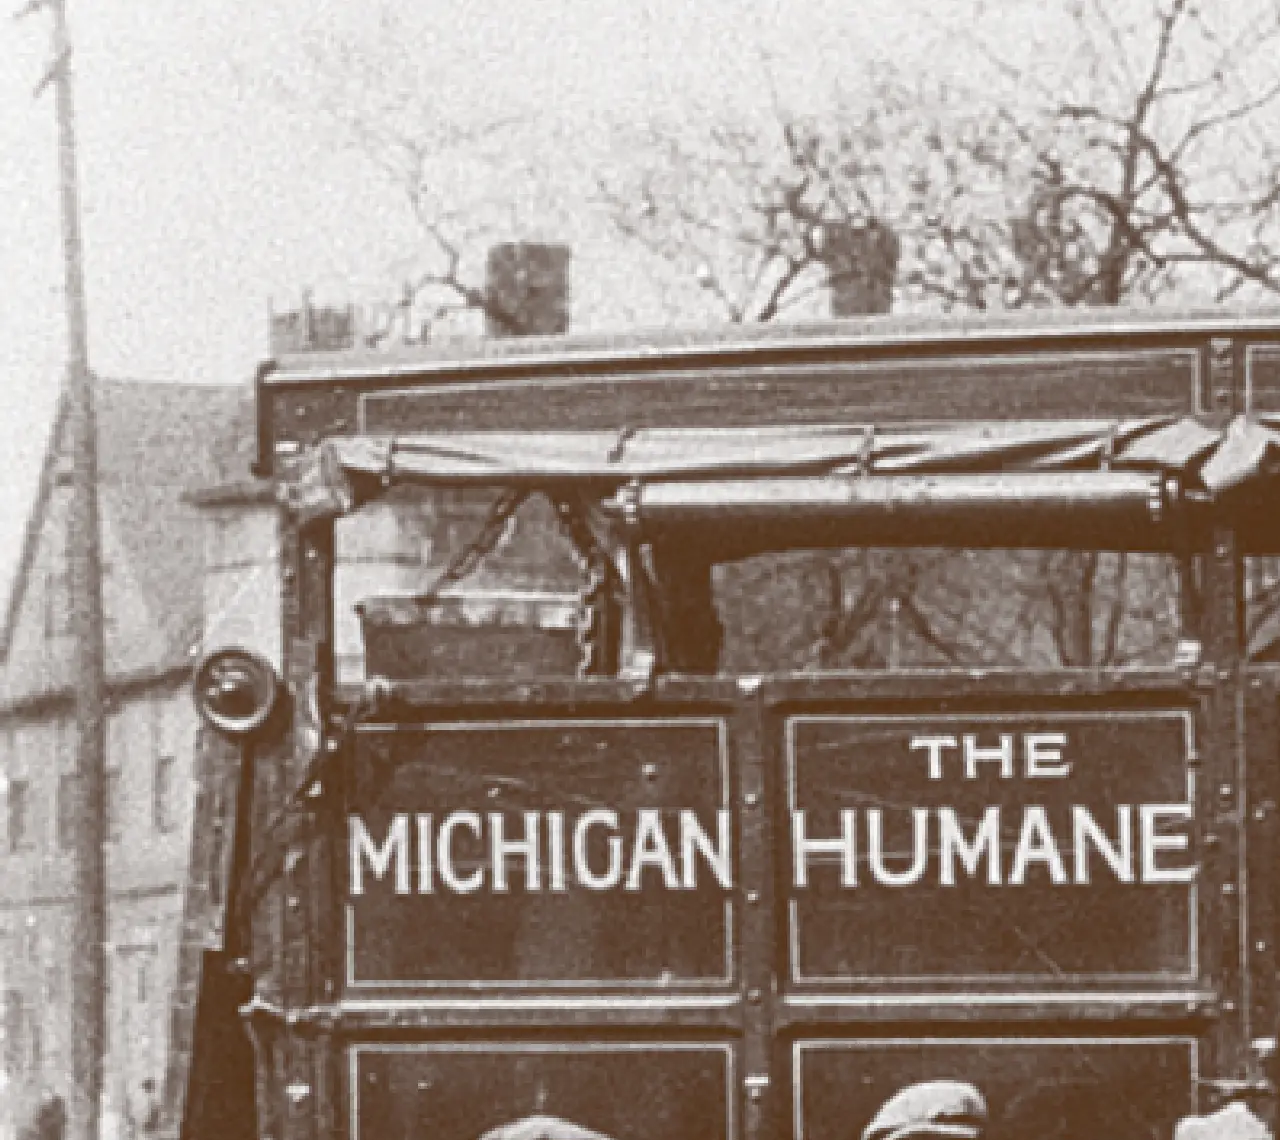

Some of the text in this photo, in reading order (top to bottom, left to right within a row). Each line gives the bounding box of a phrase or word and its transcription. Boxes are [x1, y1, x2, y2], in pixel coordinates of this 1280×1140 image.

[909, 733, 1072, 779] THE
[346, 806, 733, 894] MICHIGAN
[792, 802, 1197, 887] HUMANE
